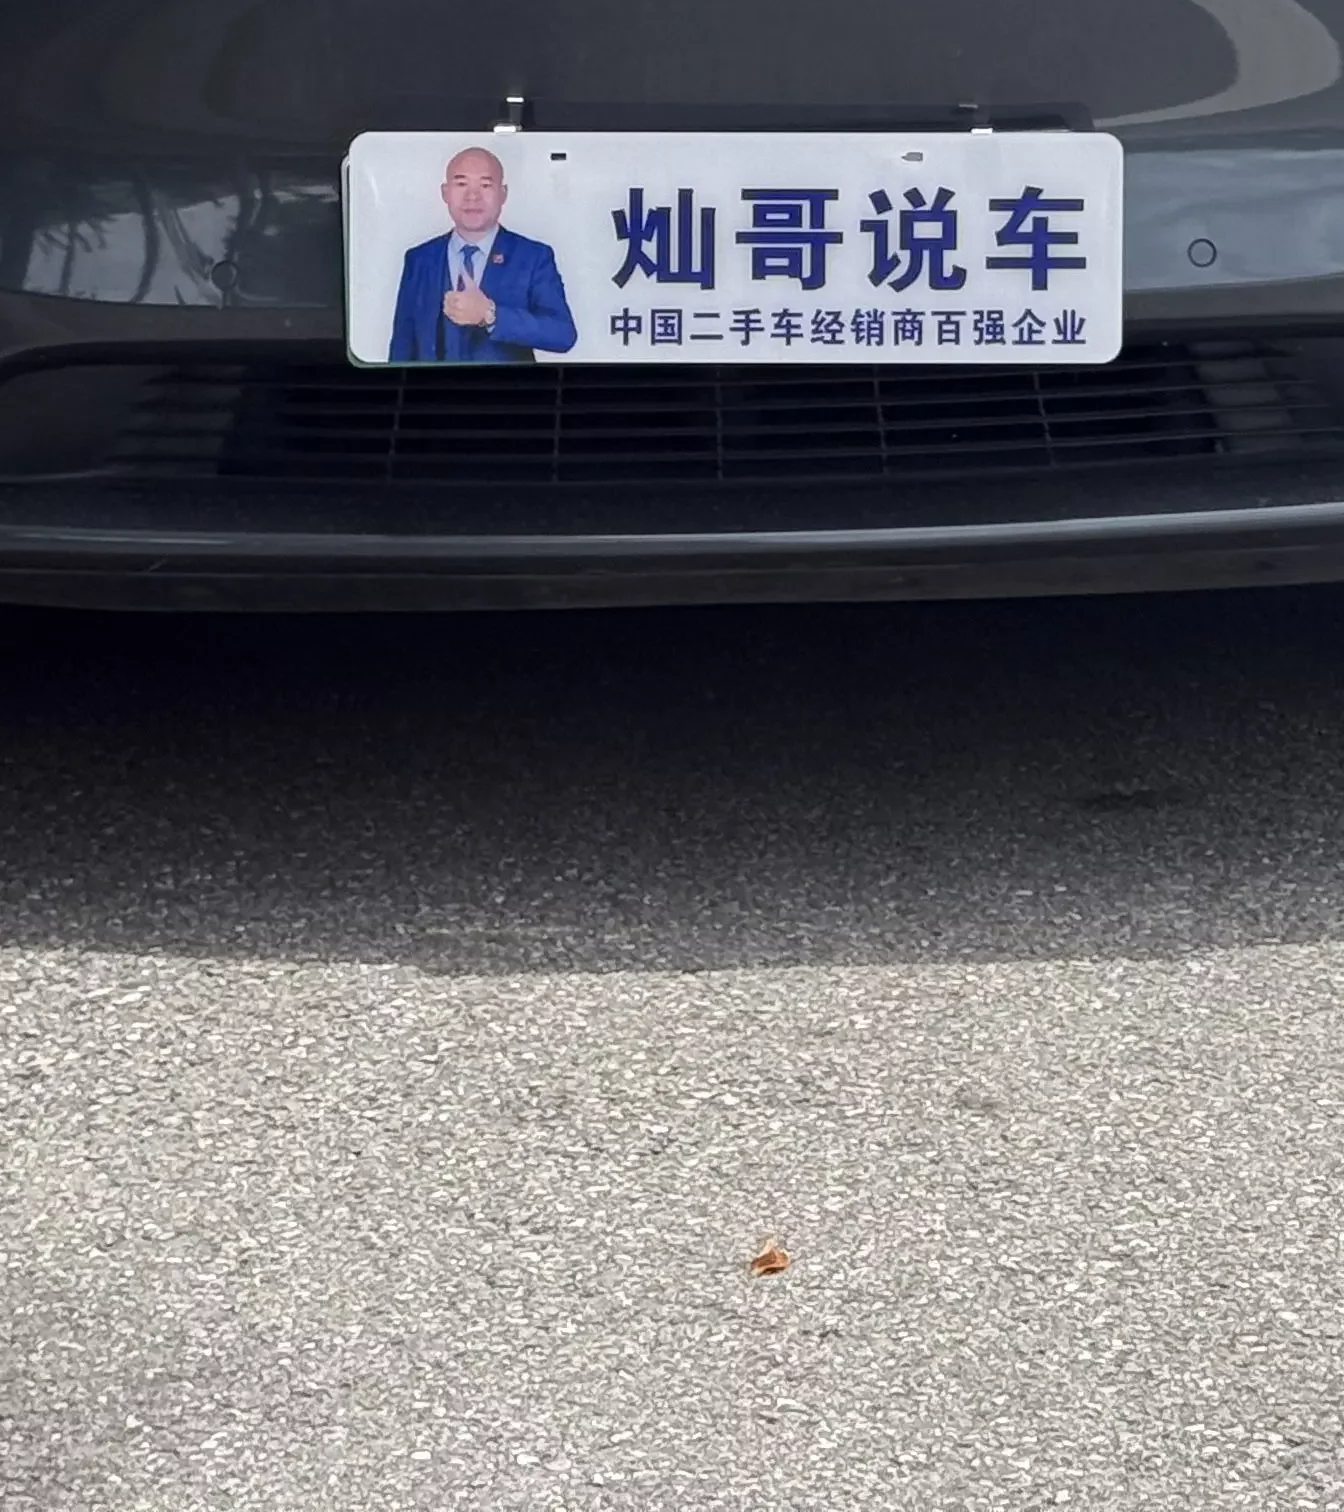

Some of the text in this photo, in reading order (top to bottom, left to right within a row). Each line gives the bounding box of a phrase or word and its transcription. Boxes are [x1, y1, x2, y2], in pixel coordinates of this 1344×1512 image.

[611, 186, 1087, 293] 灿哥说车
[610, 307, 1087, 347] 中国二手车经销商百强企业
